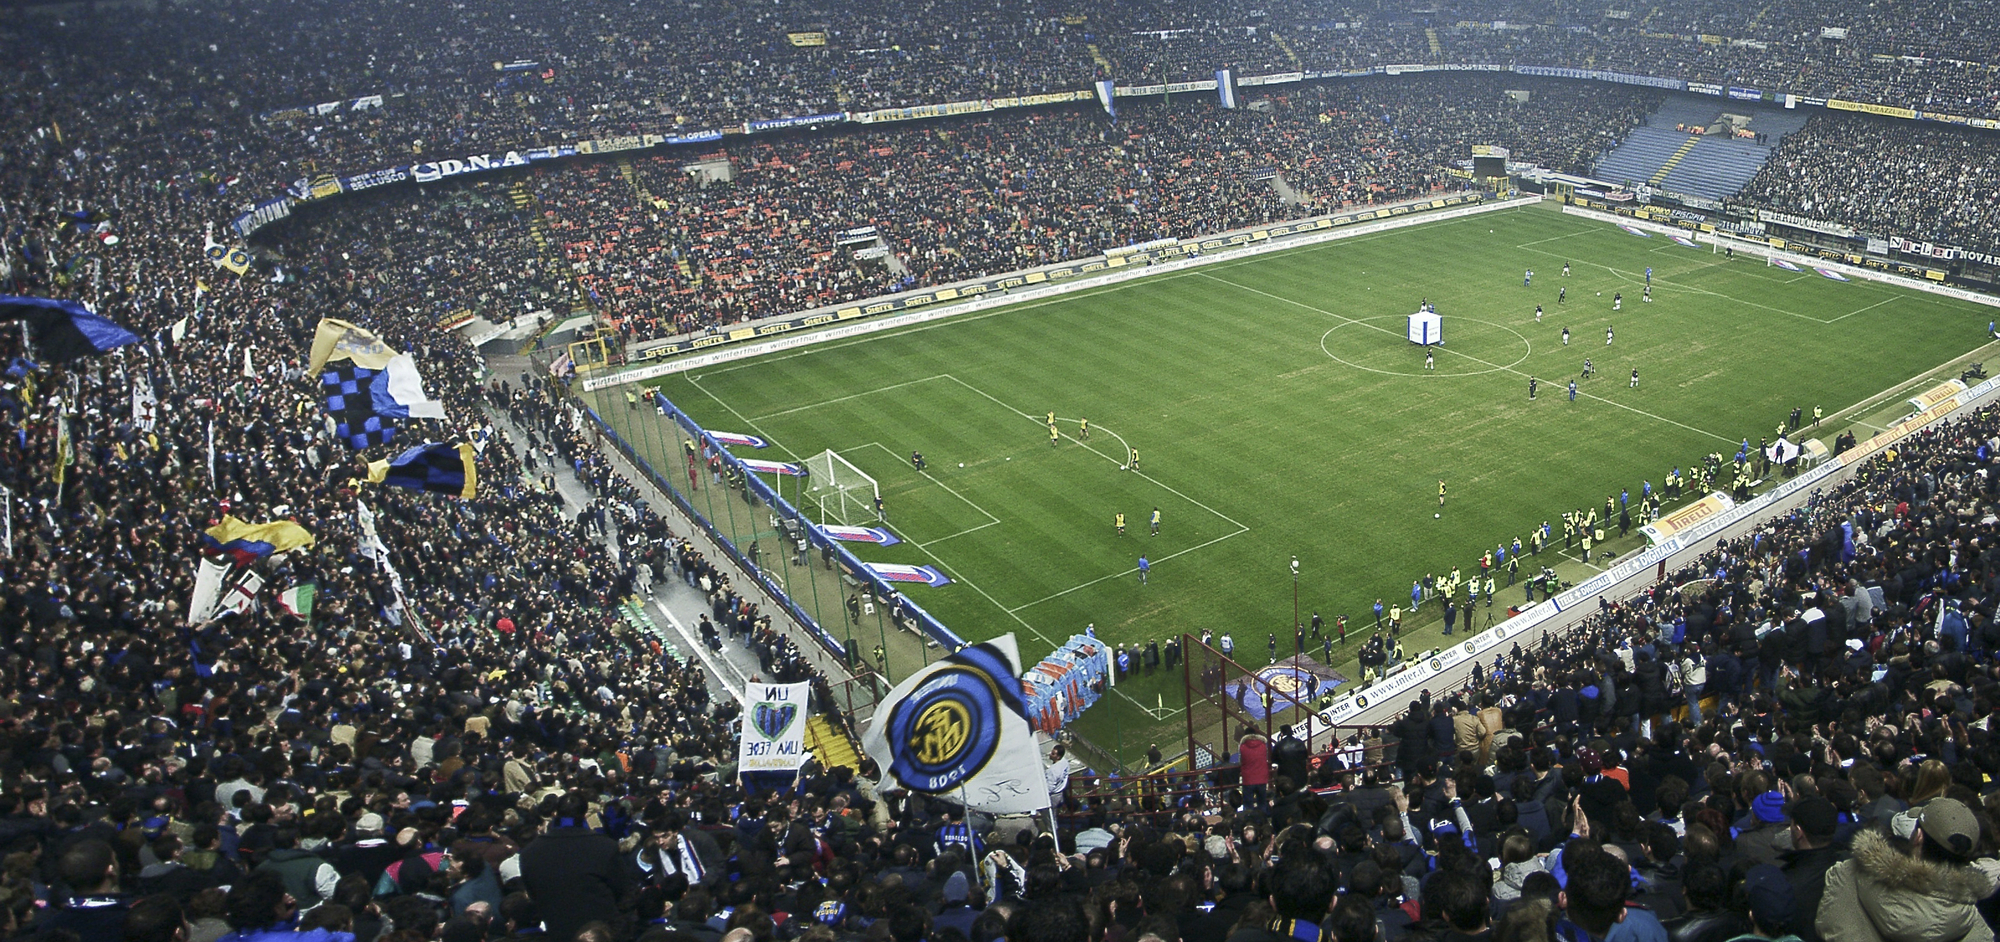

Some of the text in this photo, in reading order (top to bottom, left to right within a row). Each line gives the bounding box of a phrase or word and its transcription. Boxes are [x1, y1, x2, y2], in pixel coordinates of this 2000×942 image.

[1829, 100, 1856, 110] TORINO
[756, 122, 769, 130] LA
[770, 120, 793, 129] FEDE
[686, 128, 718, 140] OPERA
[376, 168, 396, 178] CLUB
[350, 172, 406, 191] BELLUSCO
[1145, 263, 1180, 274] winterthur
[1807, 260, 1840, 270] winterthur
[1846, 268, 1882, 278] winterthur
[998, 278, 1022, 288] Derre
[1064, 279, 1101, 290] winterthur
[1887, 276, 1925, 288] winterthur
[1021, 287, 1060, 299] winterthur
[1929, 285, 1968, 298] winterthur
[976, 295, 1016, 308] winterthur
[928, 304, 970, 318] winterthur
[804, 315, 832, 326] Dierre
[878, 314, 922, 328] winterthur
[760, 324, 791, 334] Dierre
[825, 324, 872, 338] winterthur
[692, 336, 724, 348] Dierre
[770, 334, 818, 349] winterthur
[646, 346, 678, 357] Dierre
[712, 346, 762, 362] winterthur
[652, 357, 705, 374] winterthur
[1926, 385, 1954, 402] PIRELLI
[1932, 399, 1958, 418] PIRELLI
[1904, 412, 1932, 432] PIRELLI
[1873, 427, 1902, 448] PIRELLI
[1666, 502, 1713, 530] PIRELLI
[1613, 566, 1632, 580] TELE
[1640, 541, 1677, 567] DIGITALE
[1559, 594, 1574, 607] TELE
[1580, 575, 1611, 596] DIGITALE
[1506, 602, 1554, 631] www.inter.it
[1473, 633, 1490, 645] INTER
[1440, 650, 1458, 662] INTER
[1370, 665, 1426, 699] www.inter.it
[1330, 702, 1350, 716] INTER
[1333, 710, 1354, 722] Channel
